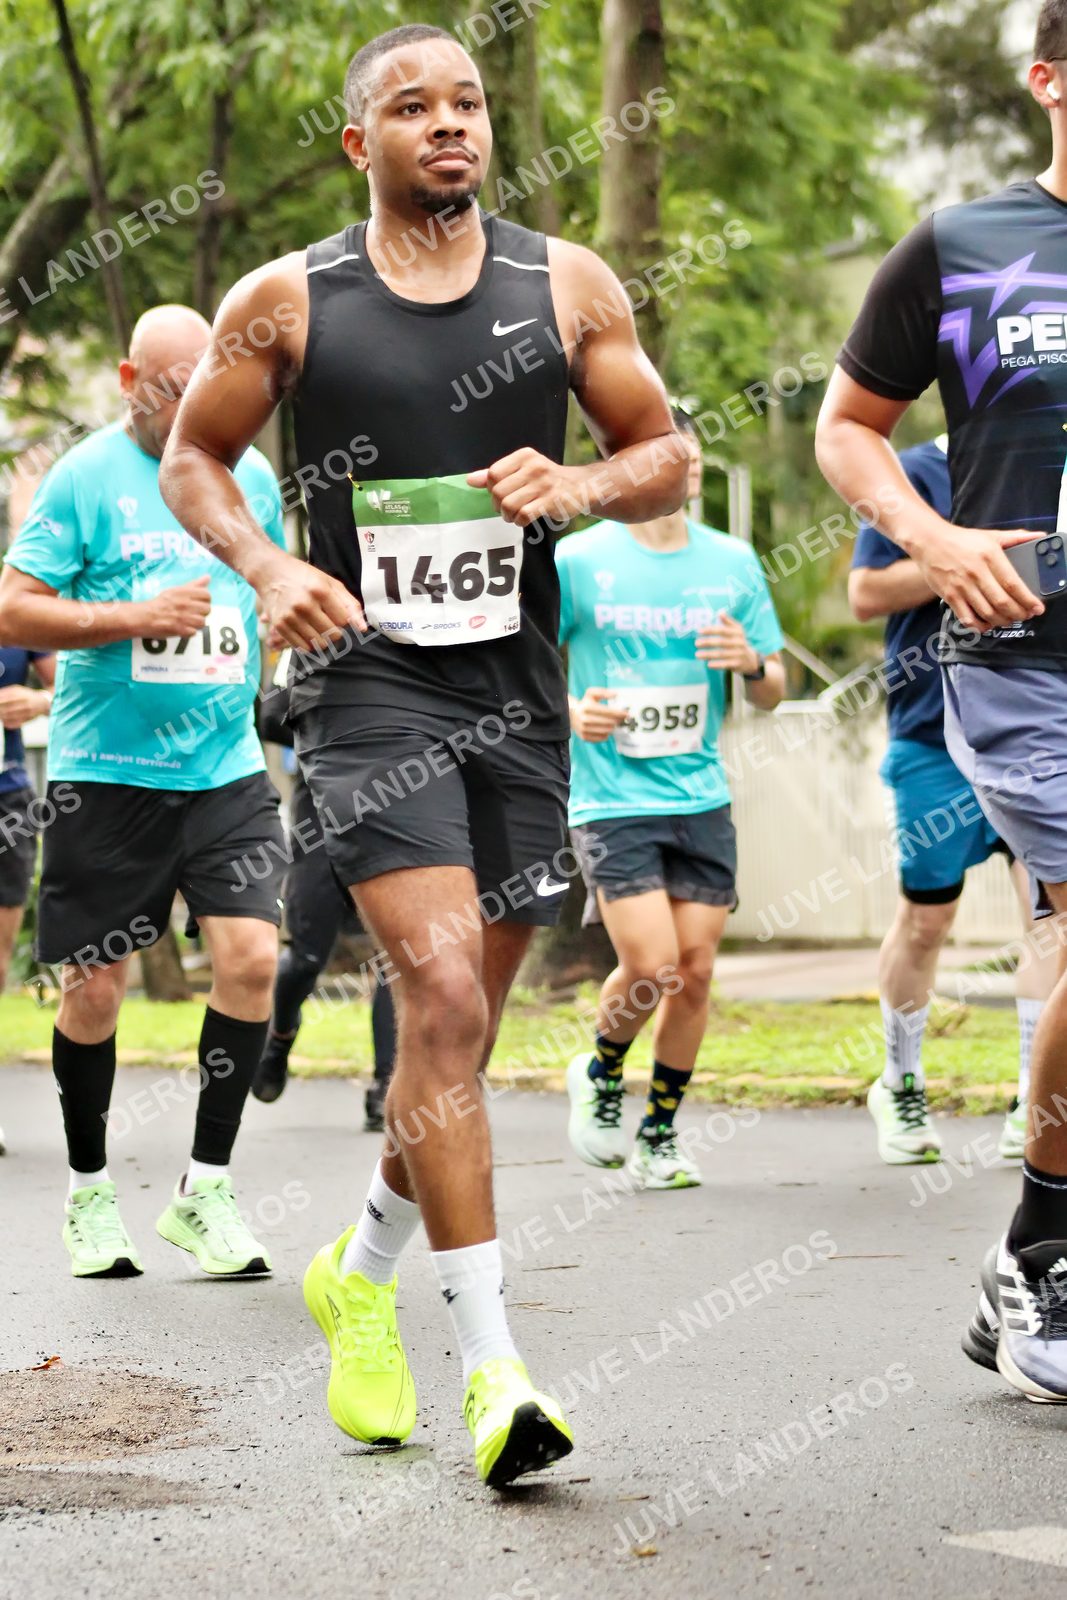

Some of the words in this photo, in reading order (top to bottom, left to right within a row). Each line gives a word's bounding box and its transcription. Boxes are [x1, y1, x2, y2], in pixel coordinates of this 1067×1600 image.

[997, 313, 1067, 356] PE
[1001, 355, 1036, 369] PEGA
[120, 531, 205, 562] PERD
[377, 545, 516, 604] 1465
[379, 621, 414, 630] PERDURA
[433, 622, 461, 630] BROOKS
[619, 704, 699, 732] 4958
